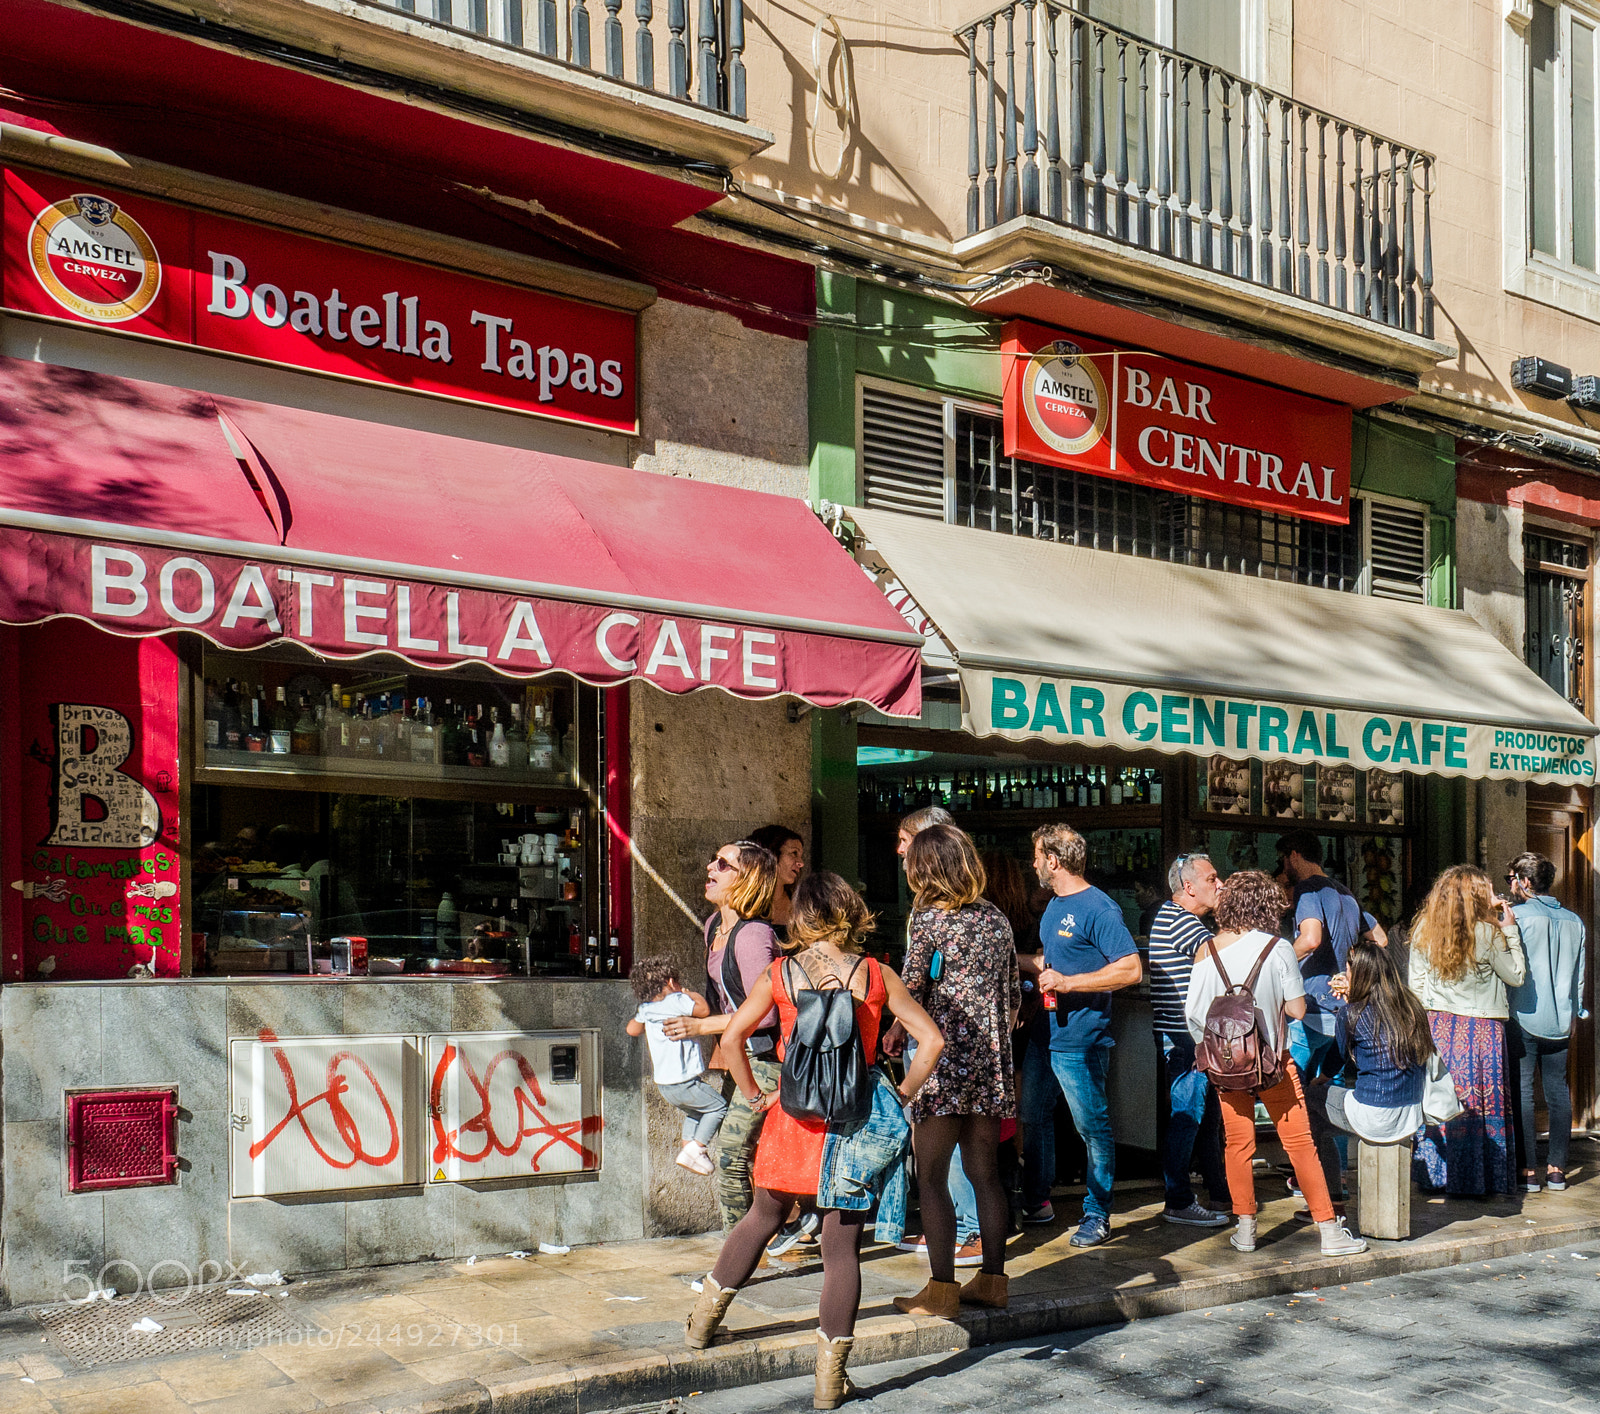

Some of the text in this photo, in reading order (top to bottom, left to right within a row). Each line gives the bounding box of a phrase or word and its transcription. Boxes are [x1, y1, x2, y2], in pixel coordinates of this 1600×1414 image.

[57, 237, 135, 266] AMSTEL
[63, 262, 127, 283] CERVEZA
[207, 249, 624, 402] Boatella Tapas
[1041, 379, 1094, 404] AMSTEL
[1123, 366, 1217, 425] BAR
[1045, 401, 1087, 420] CERVEZA
[1137, 426, 1343, 506] CENTRAL
[91, 544, 552, 666] BOATELLA
[595, 612, 777, 689] CAFE
[990, 677, 1468, 769] BAR CENTRAL CAFE
[1494, 730, 1585, 755] PRODUCTOS
[1490, 752, 1594, 776] EXTREMEÑOS
